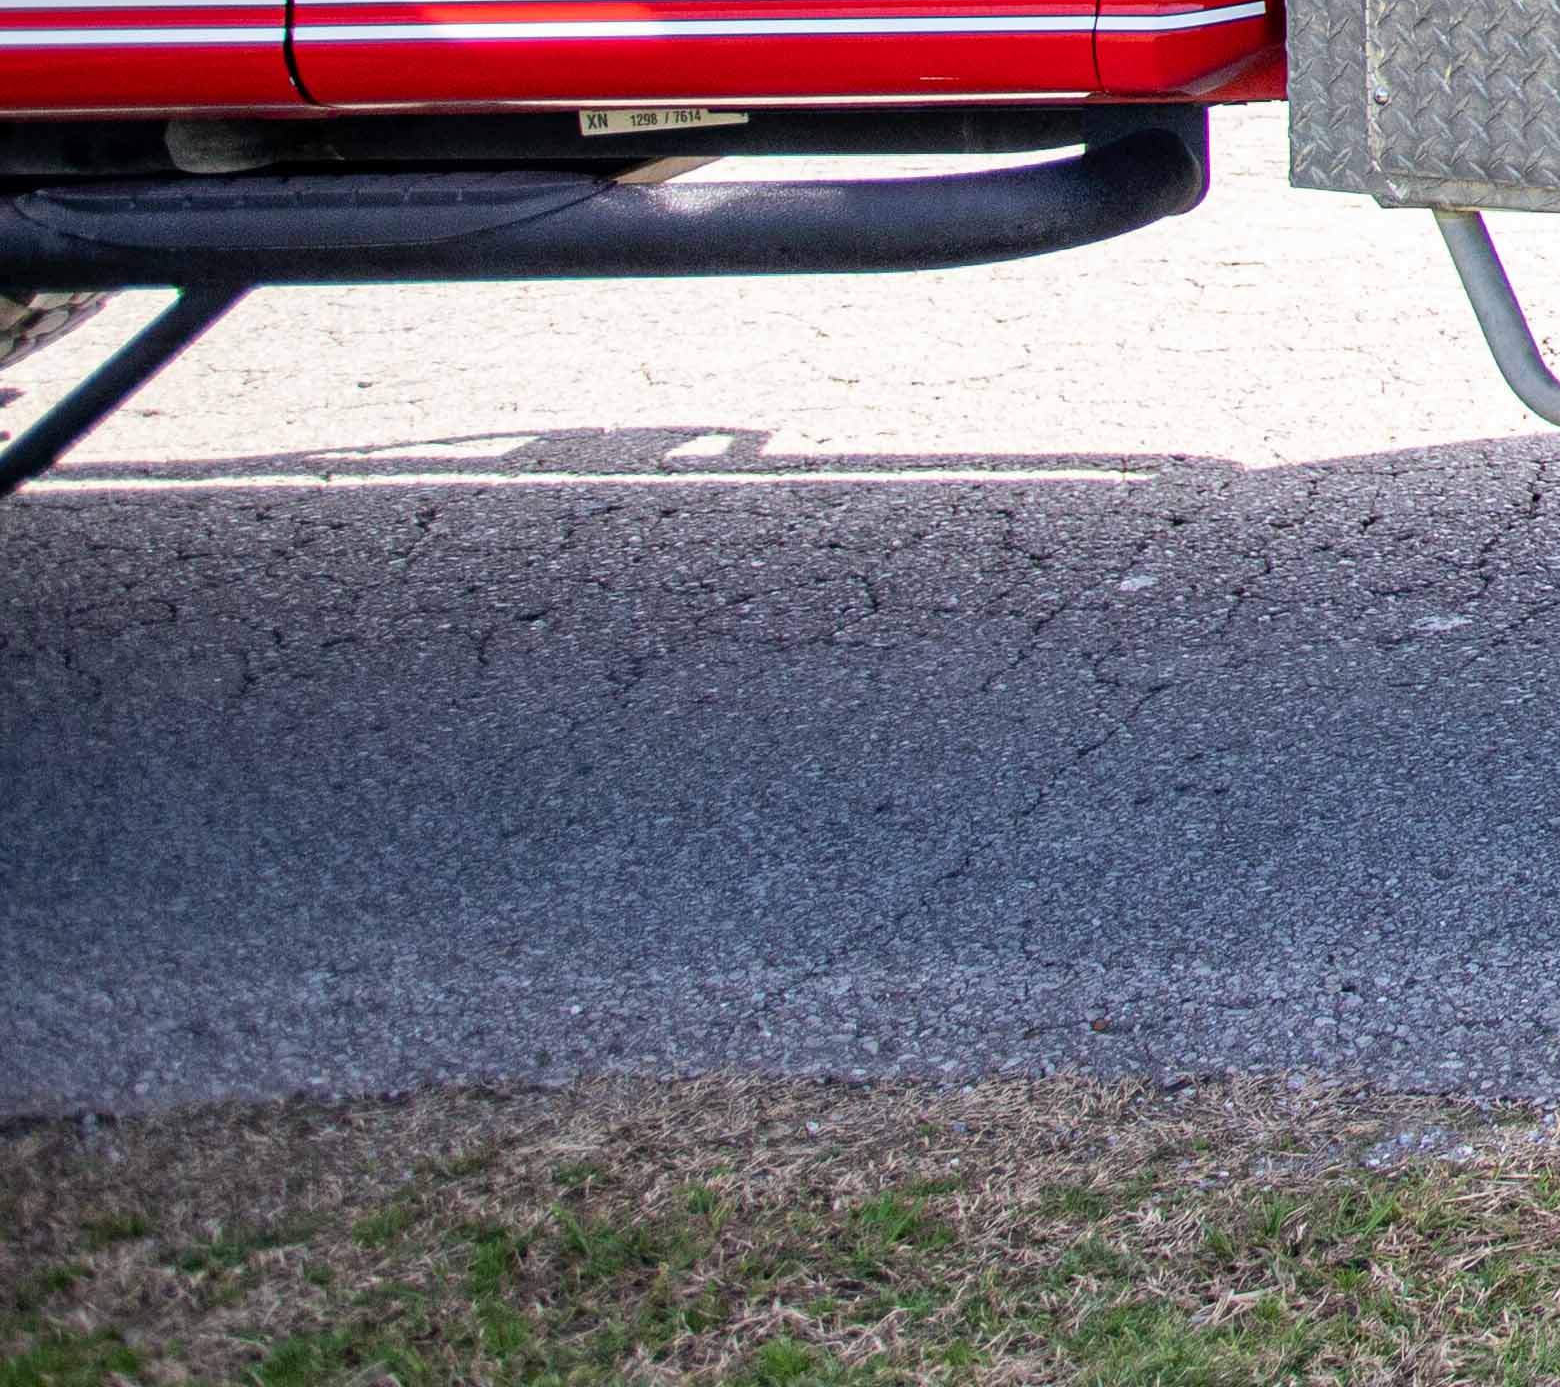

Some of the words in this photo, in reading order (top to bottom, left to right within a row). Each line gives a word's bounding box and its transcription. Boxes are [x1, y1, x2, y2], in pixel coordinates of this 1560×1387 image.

[587, 113, 609, 130] XN
[630, 113, 658, 127] 1298
[674, 110, 702, 124] 7614
